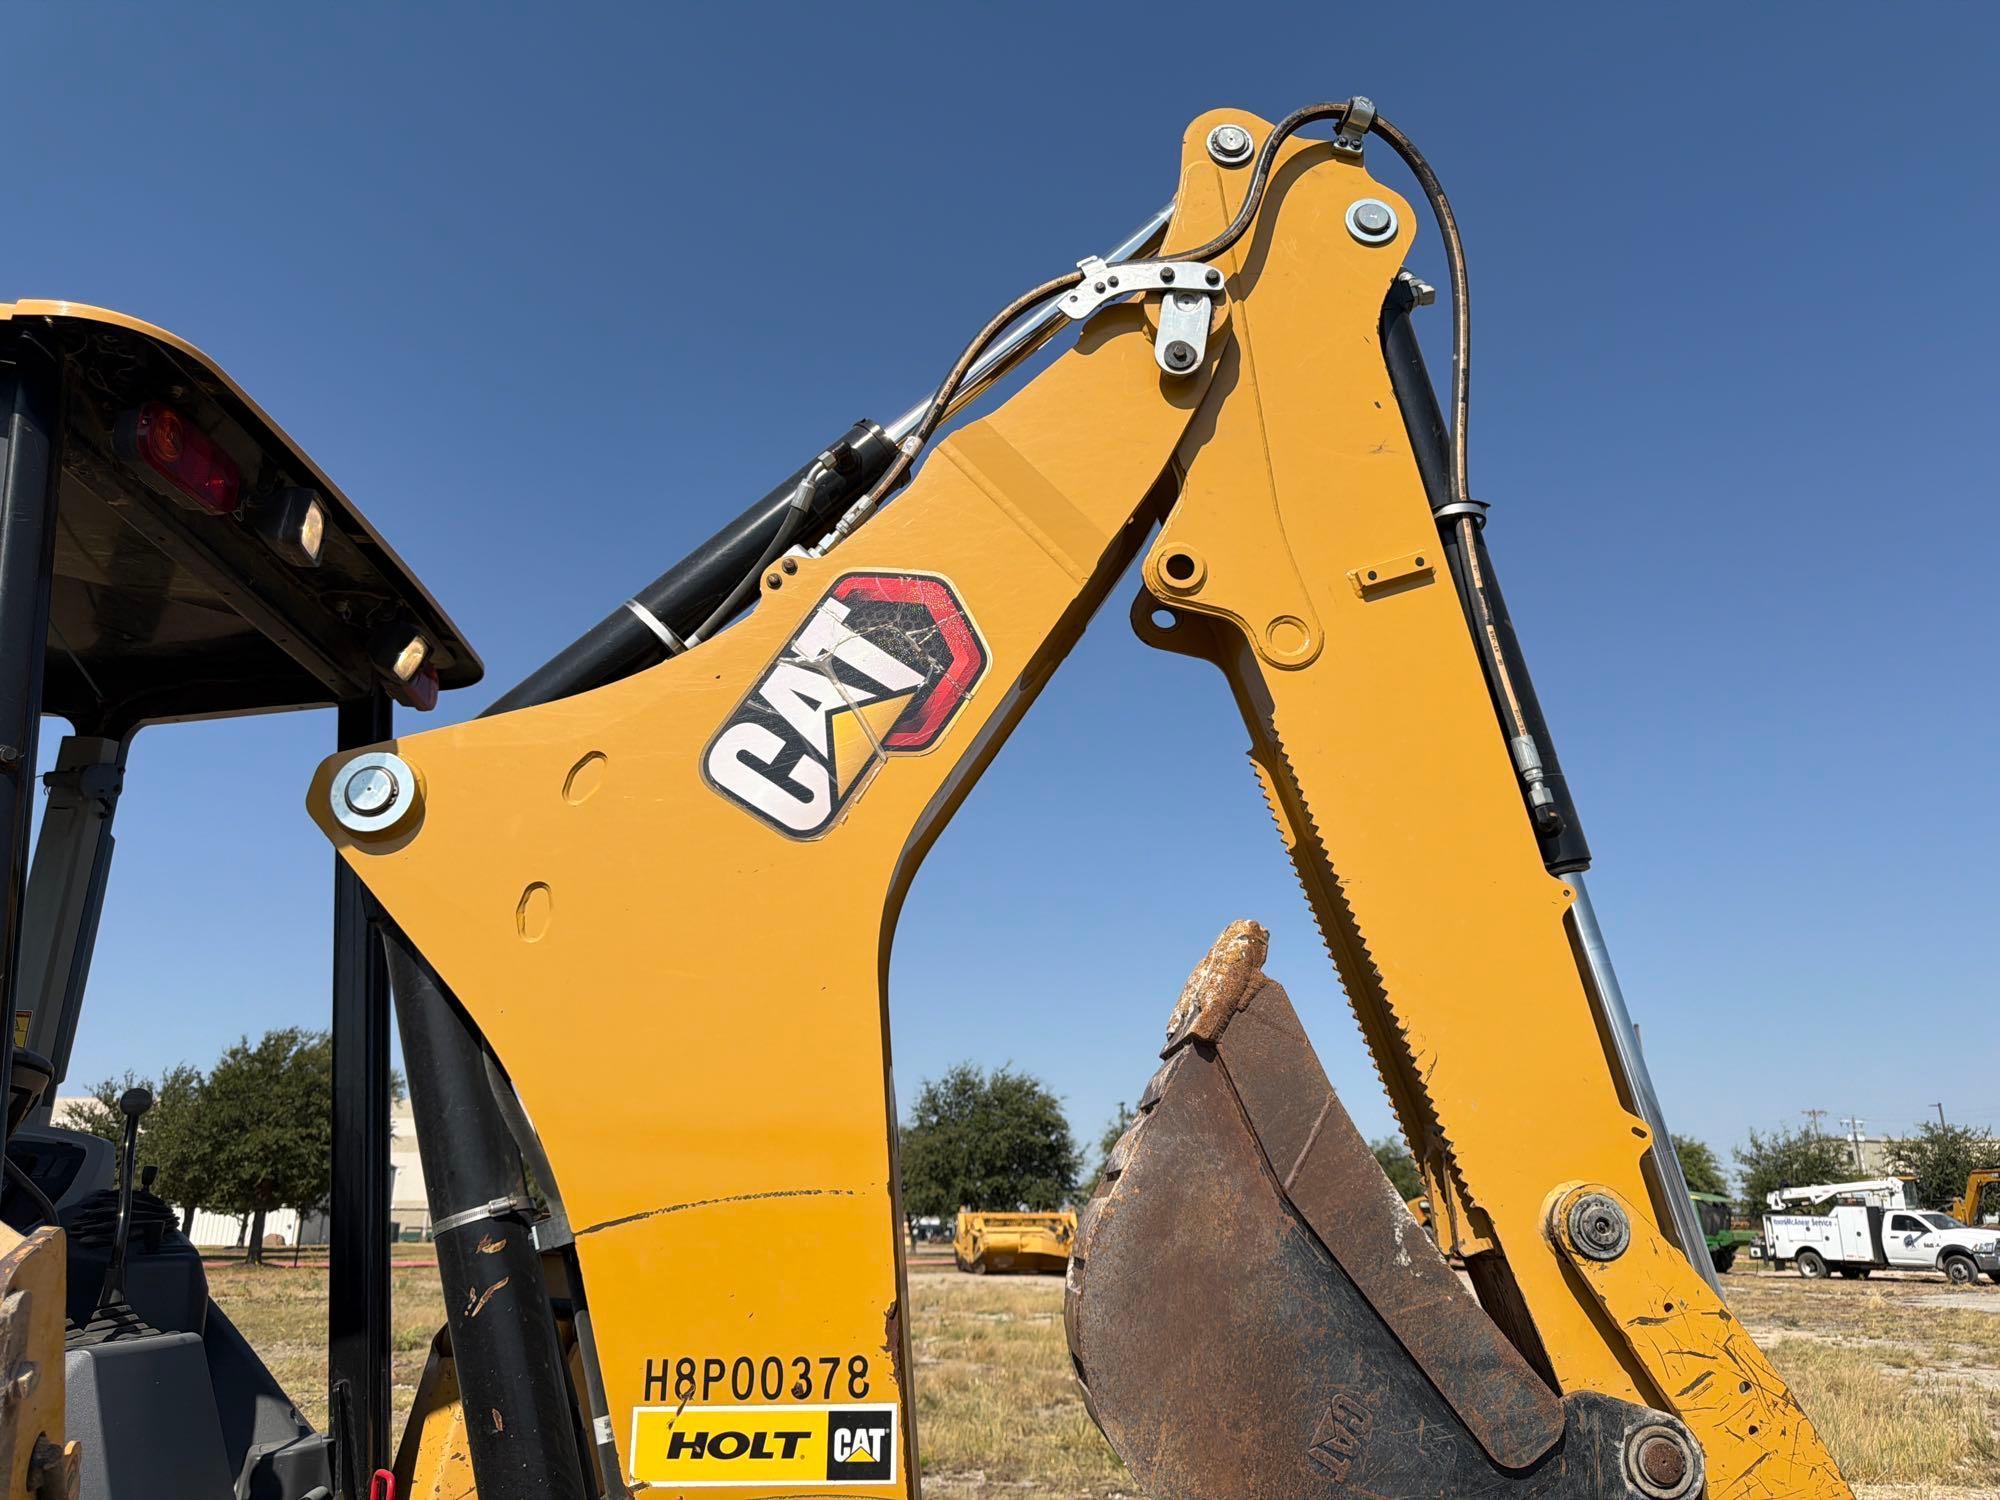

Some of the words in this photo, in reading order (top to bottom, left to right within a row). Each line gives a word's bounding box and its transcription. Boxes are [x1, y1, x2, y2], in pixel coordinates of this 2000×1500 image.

[708, 597, 926, 831] CAT
[1812, 1218, 1832, 1228] Service
[644, 1355, 870, 1401] H8P00378
[666, 1431, 812, 1460] HOLT
[833, 1427, 887, 1463] CAT
[1307, 1393, 1374, 1484] CAT
